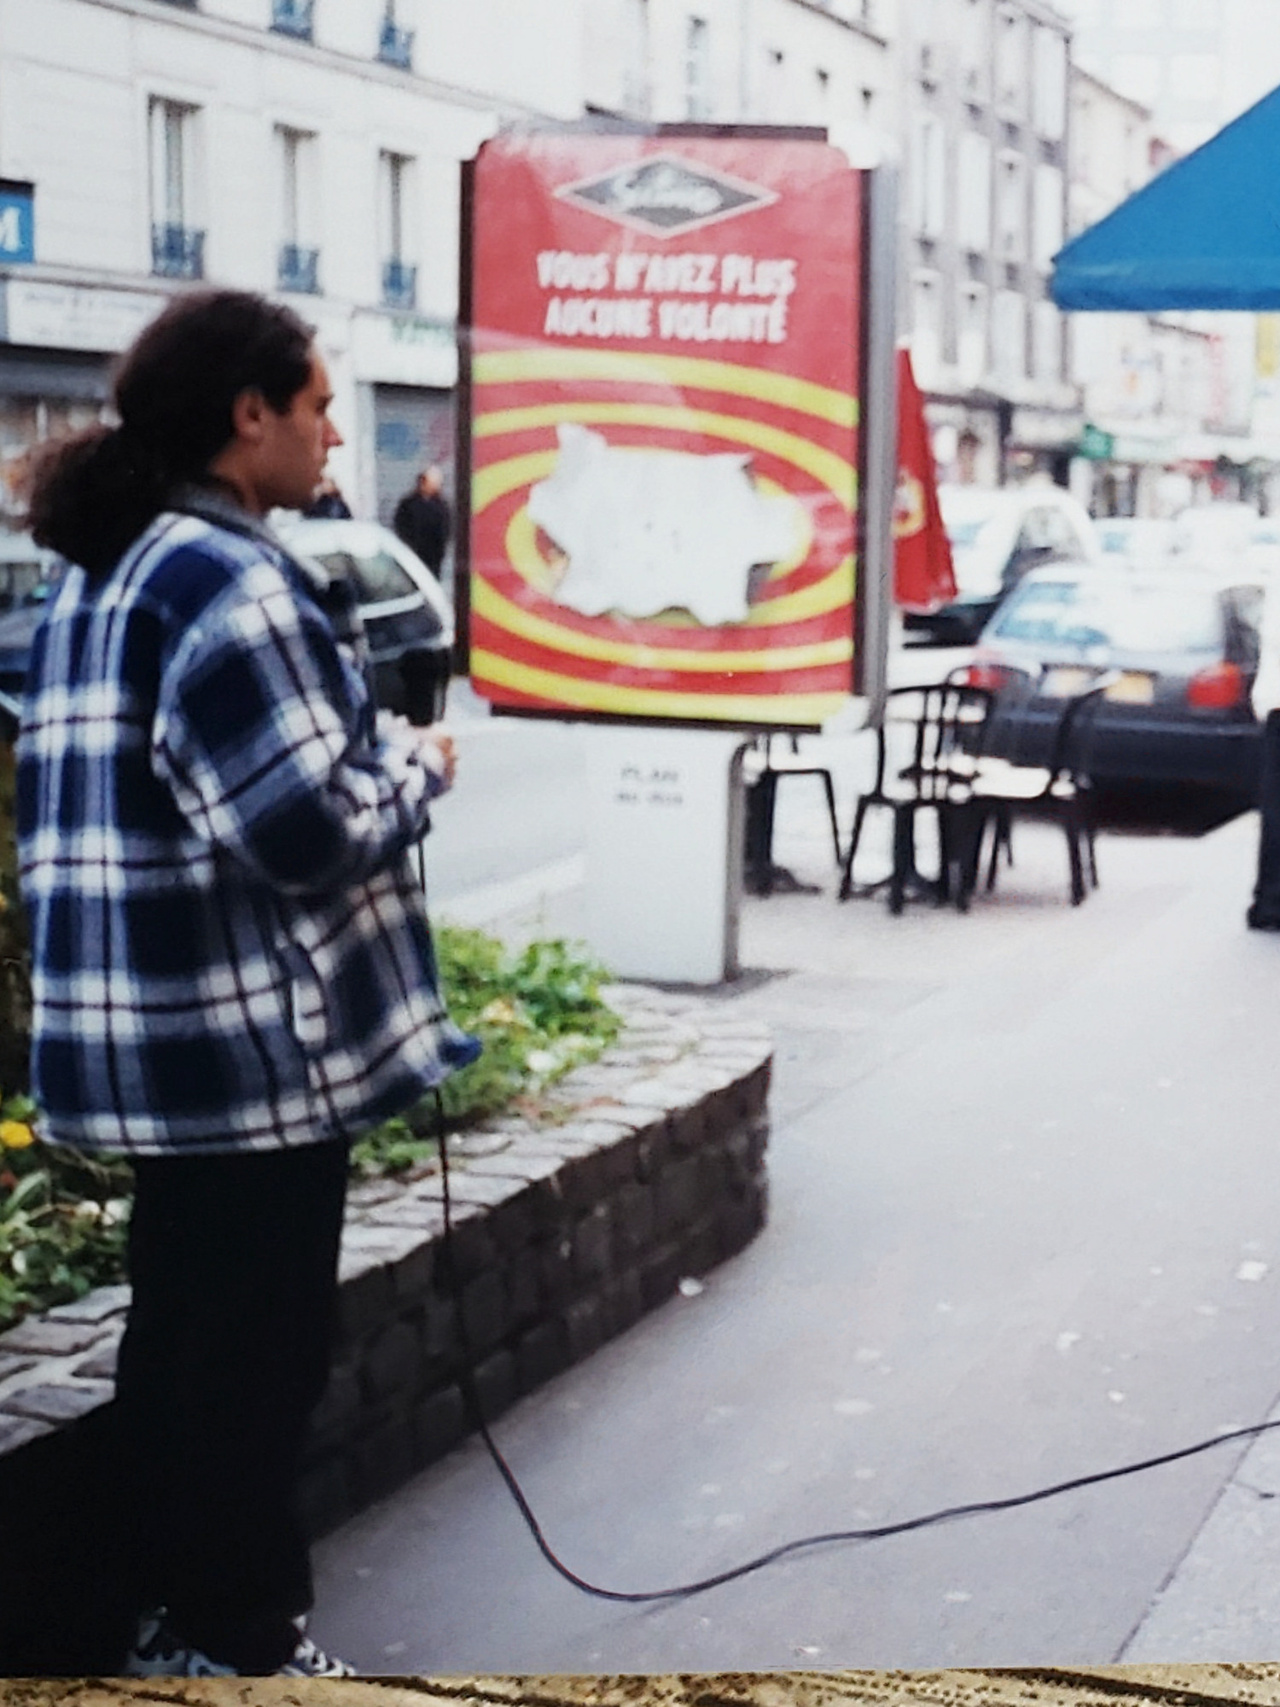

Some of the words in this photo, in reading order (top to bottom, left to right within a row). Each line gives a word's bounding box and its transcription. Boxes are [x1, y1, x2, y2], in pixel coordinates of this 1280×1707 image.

[537, 250, 611, 291] VOUS
[614, 252, 718, 293] N'AVEZ
[721, 253, 798, 298] PLUS
[544, 297, 654, 339] AUCUNE
[658, 298, 789, 343] VOLONTÉ
